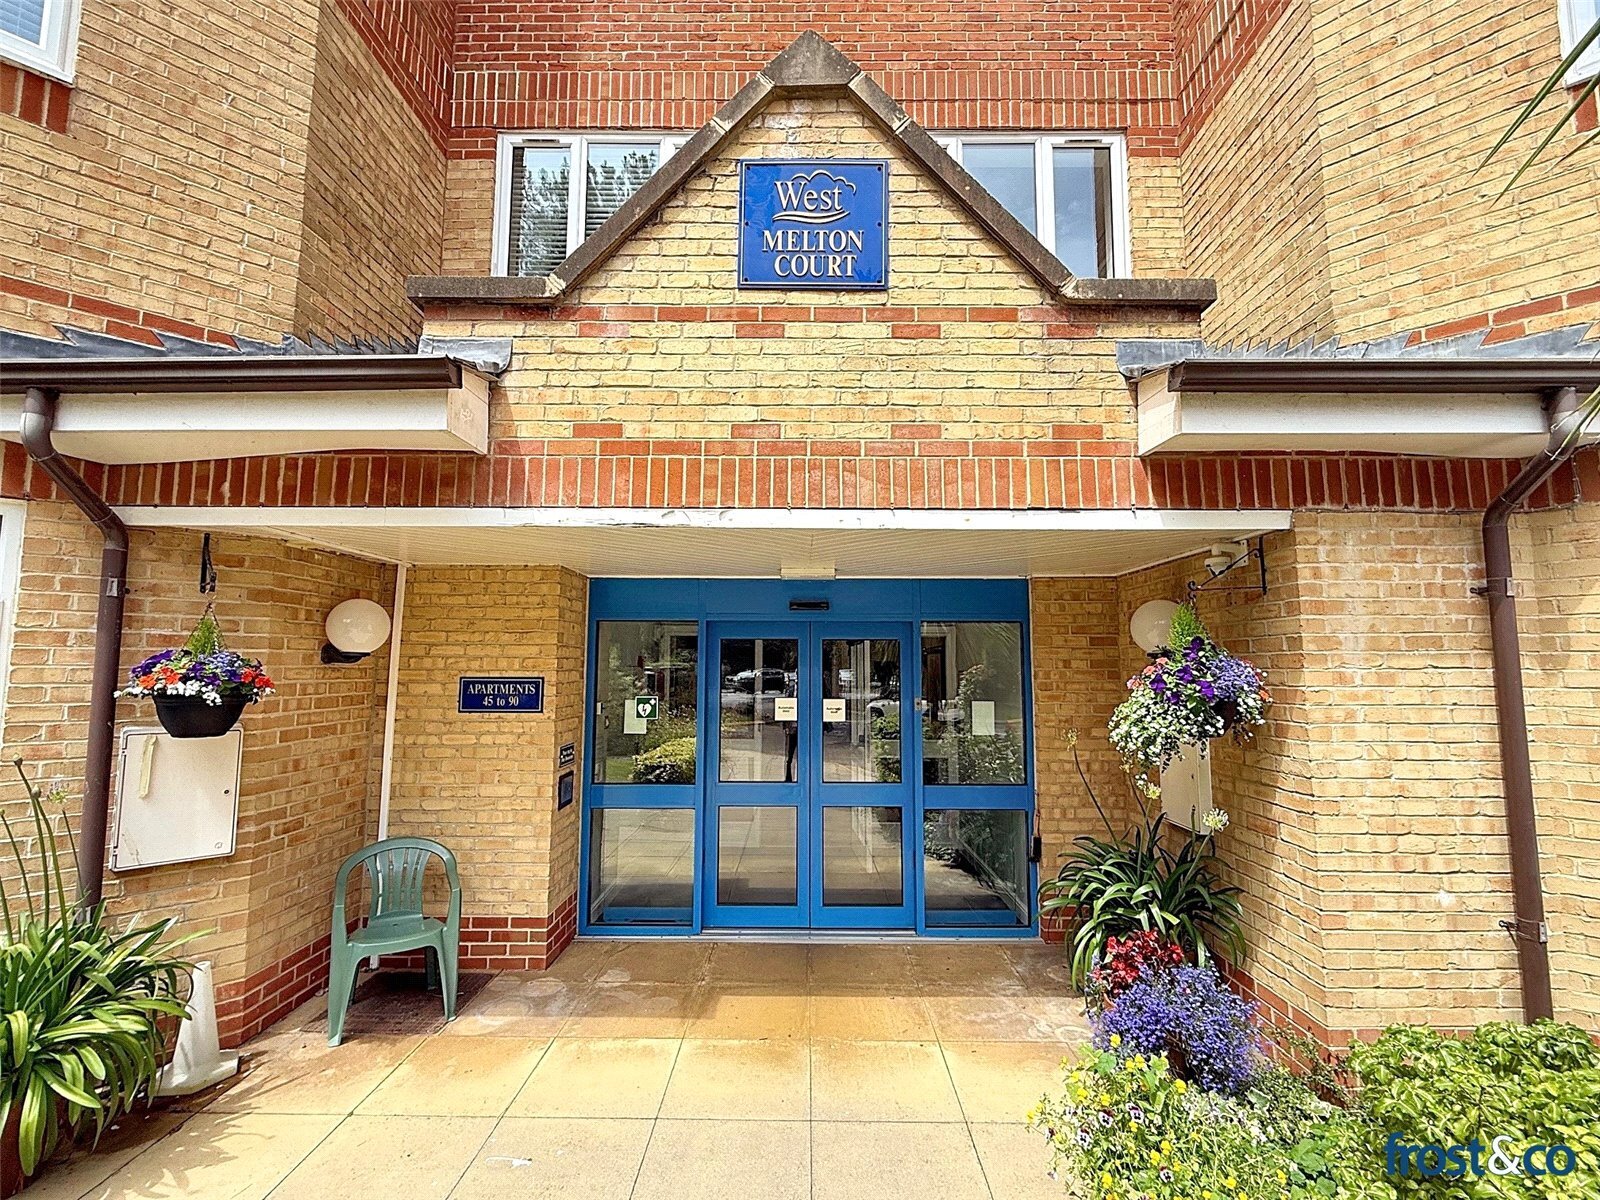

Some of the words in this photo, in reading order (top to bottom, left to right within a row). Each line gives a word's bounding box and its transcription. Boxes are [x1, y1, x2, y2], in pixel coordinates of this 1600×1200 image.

[774, 181, 843, 211] West
[762, 230, 863, 252] MELTON
[774, 255, 857, 277] COURT
[467, 684, 536, 695] APARTMENTS
[482, 695, 494, 706] 45
[496, 697, 506, 706] to
[508, 695, 519, 706] 90
